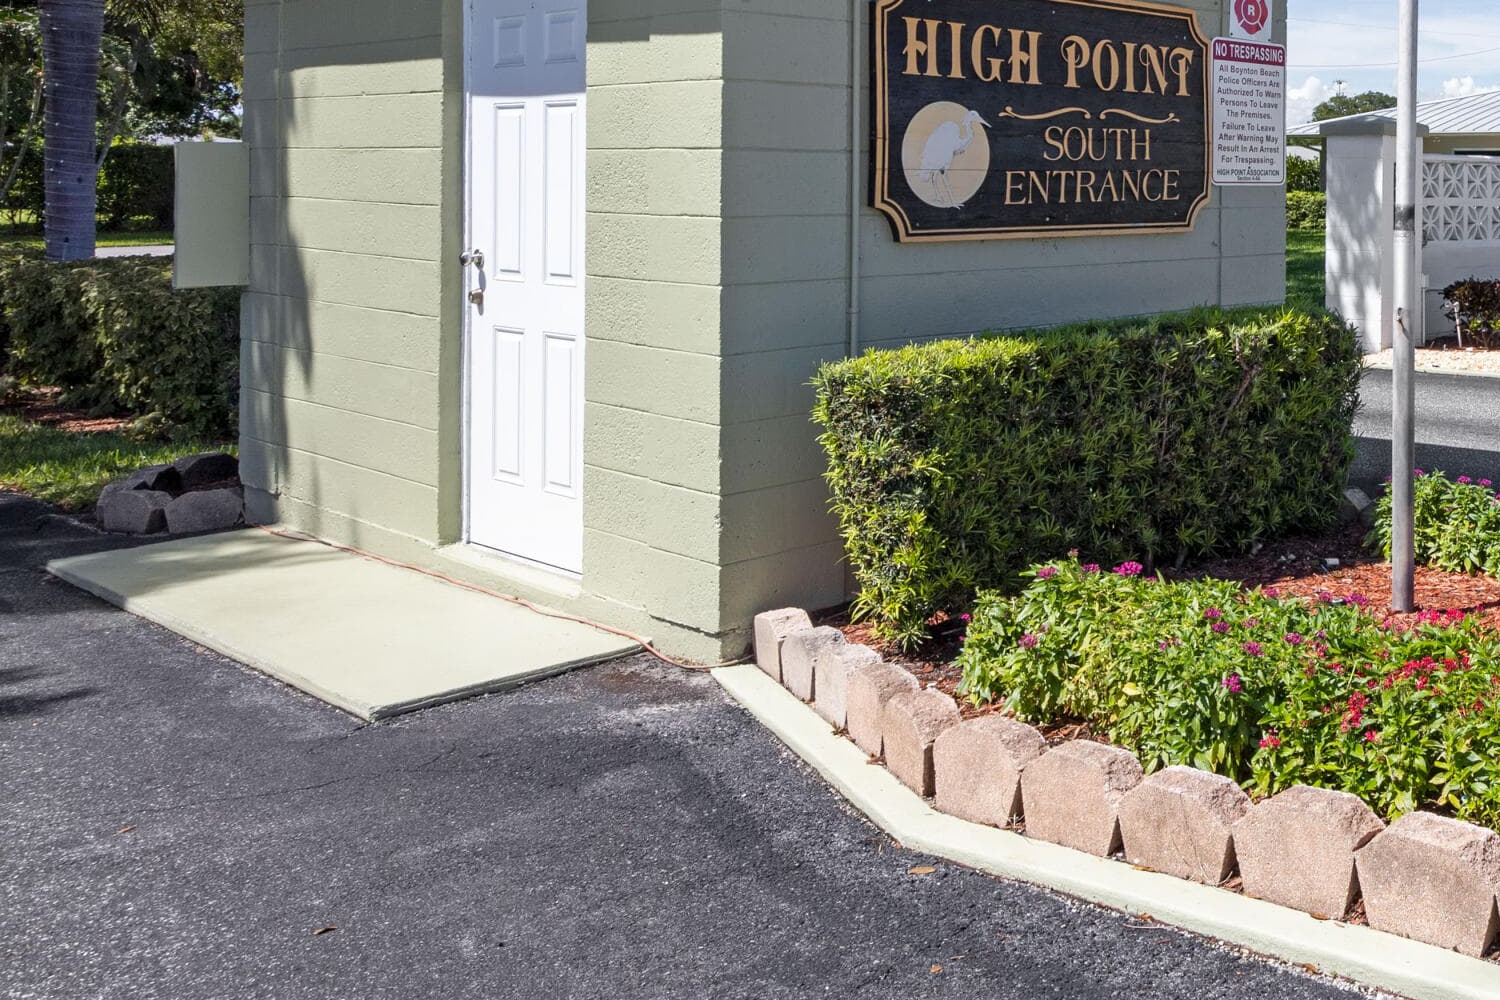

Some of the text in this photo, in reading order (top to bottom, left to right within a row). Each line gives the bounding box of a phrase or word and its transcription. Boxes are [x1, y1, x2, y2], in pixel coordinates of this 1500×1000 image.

[1248, 4, 1255, 16] R
[902, 16, 1194, 97] HIGH POINT
[1215, 42, 1283, 63] NO TRESPASSING
[1230, 66, 1258, 75] Boynton
[1260, 68, 1279, 77] Beach
[1219, 76, 1240, 85] Police
[1242, 78, 1267, 87] Officers
[1217, 88, 1254, 96] Authorized
[1221, 98, 1247, 107] Persons
[1260, 101, 1278, 109] Leave
[1241, 111, 1272, 119] Premises.
[1222, 122, 1245, 130] Failure
[1257, 124, 1275, 132] Leave
[1043, 126, 1152, 161] SOUTH
[1237, 134, 1264, 144] Warning
[1266, 136, 1278, 144] May
[1218, 144, 1239, 152] Result
[1222, 155, 1232, 163] For
[1004, 169, 1180, 206] ENTRANCE
